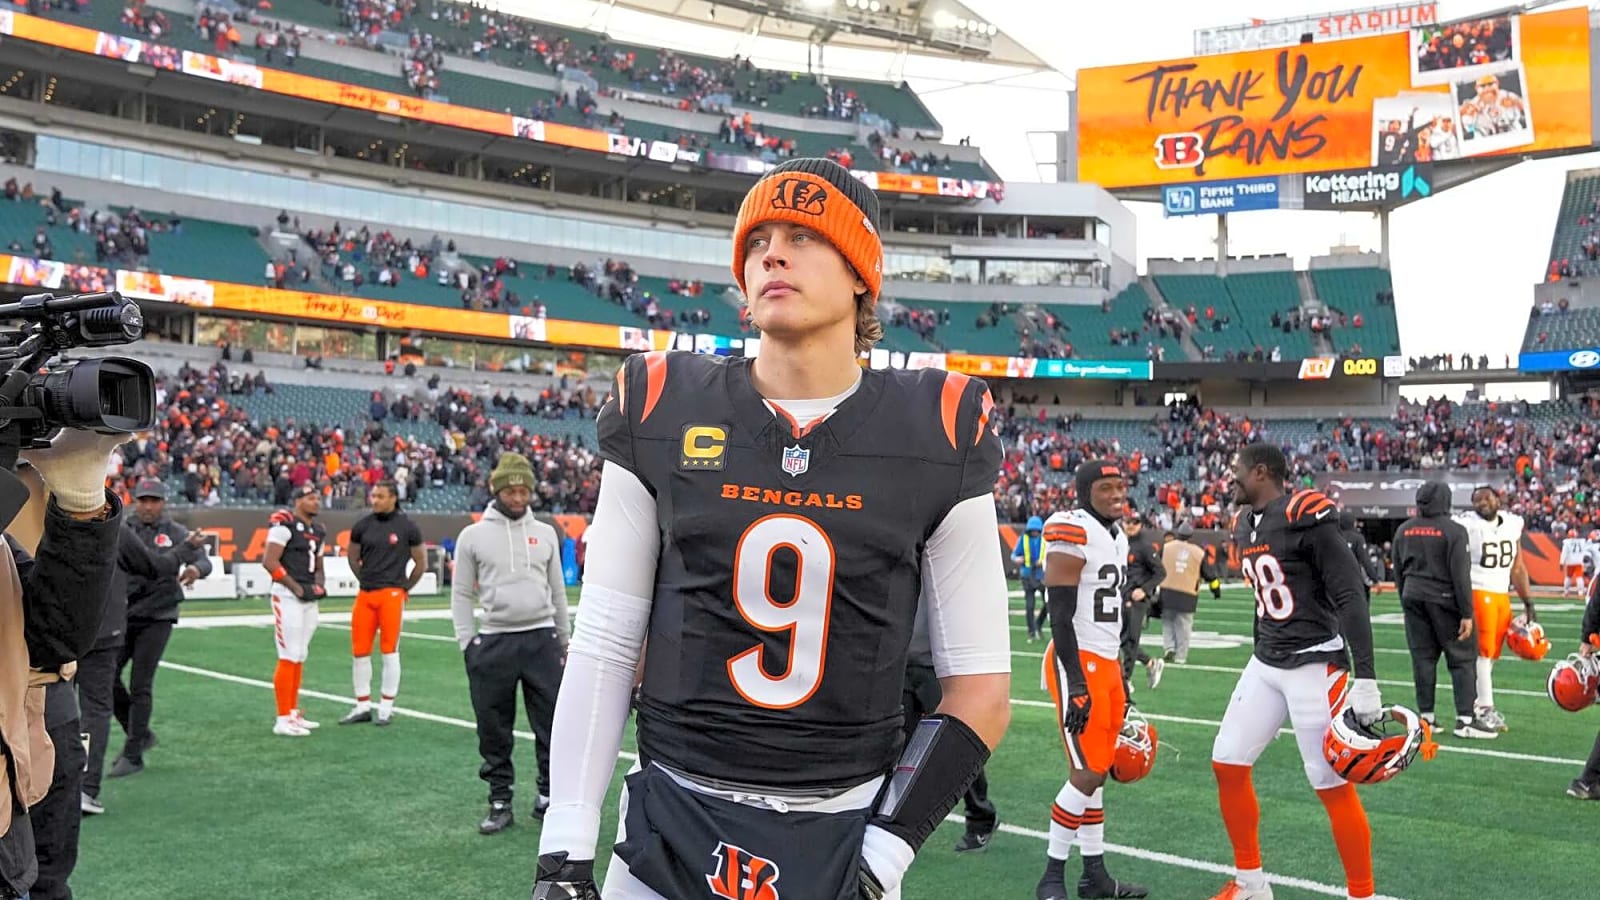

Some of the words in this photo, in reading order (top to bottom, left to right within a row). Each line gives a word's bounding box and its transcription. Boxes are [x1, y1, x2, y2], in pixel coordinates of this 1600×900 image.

[1319, 4, 1437, 36] STADIUM
[1200, 185, 1234, 199] FIFTH
[1237, 183, 1276, 196] THIRD
[1306, 171, 1399, 193] Kettering
[1200, 197, 1235, 209] BANK
[1331, 190, 1386, 204] HEALTH
[683, 426, 726, 458] C
[785, 458, 804, 470] NFL
[720, 483, 863, 510] BENGALS
[1482, 540, 1514, 569] 68
[1094, 563, 1127, 622] 2
[726, 513, 836, 710] 9
